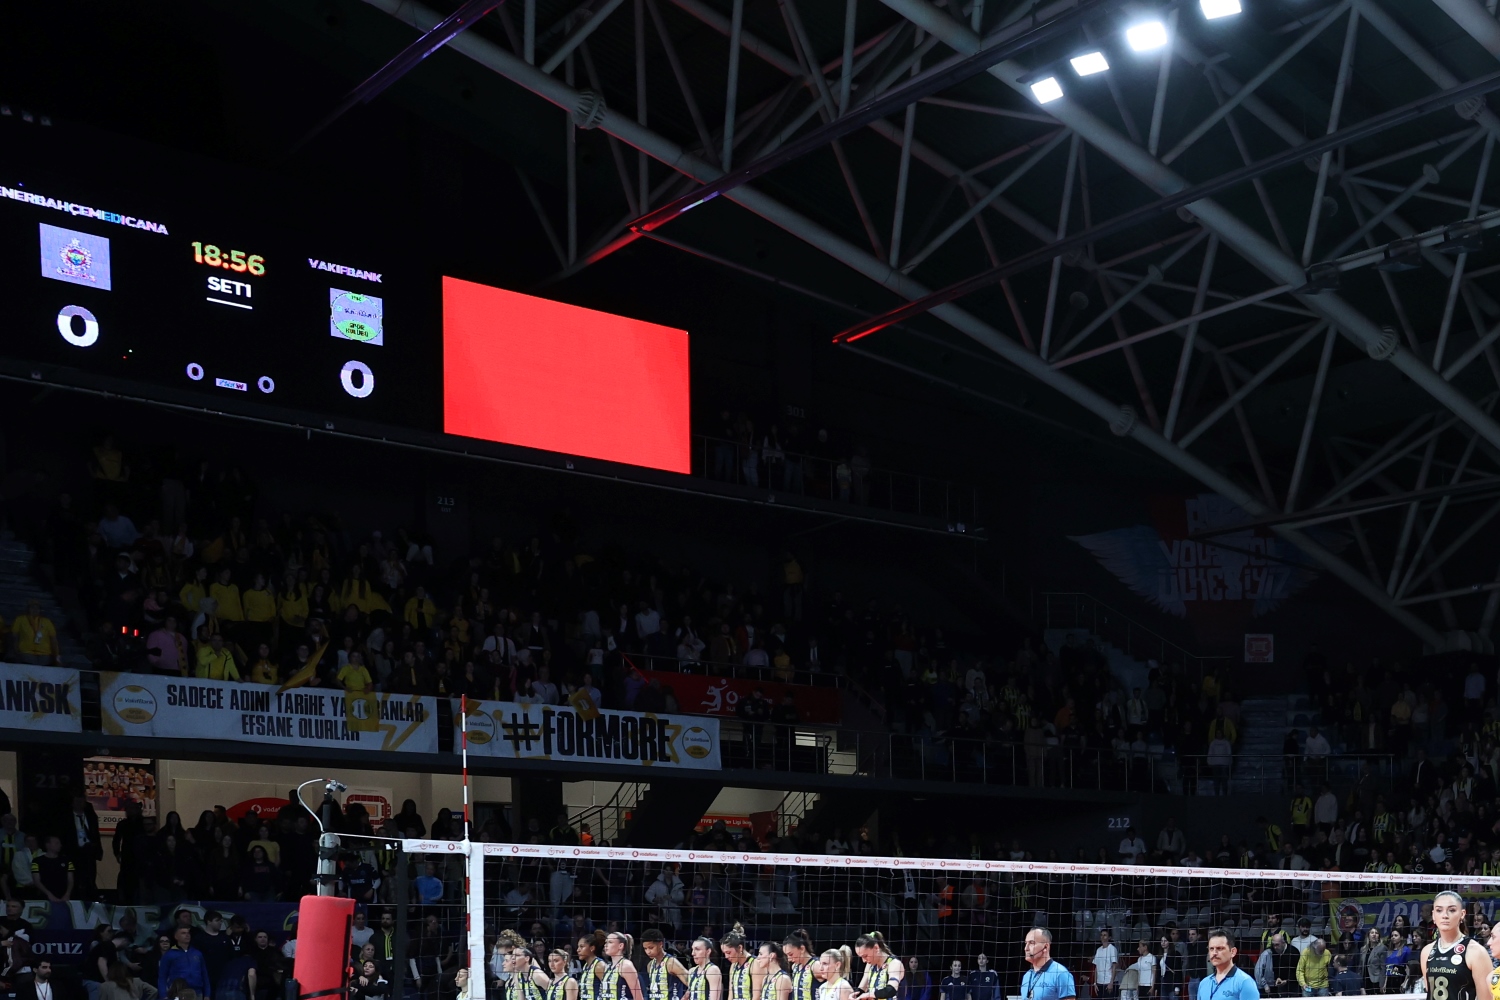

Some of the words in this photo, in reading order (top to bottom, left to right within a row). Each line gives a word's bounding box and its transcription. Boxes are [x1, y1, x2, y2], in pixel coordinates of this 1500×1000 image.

[191, 241, 267, 276] 18:56
[308, 258, 383, 283] VAKIFBANK
[57, 305, 99, 347] 0
[187, 362, 204, 381] 0
[257, 376, 275, 393] 0
[341, 360, 375, 398] 0
[0, 679, 71, 715] NKSK
[167, 684, 224, 709] SADECE
[230, 688, 270, 712] ADINI
[241, 714, 294, 737] EFSANE
[1108, 817, 1130, 829] 212
